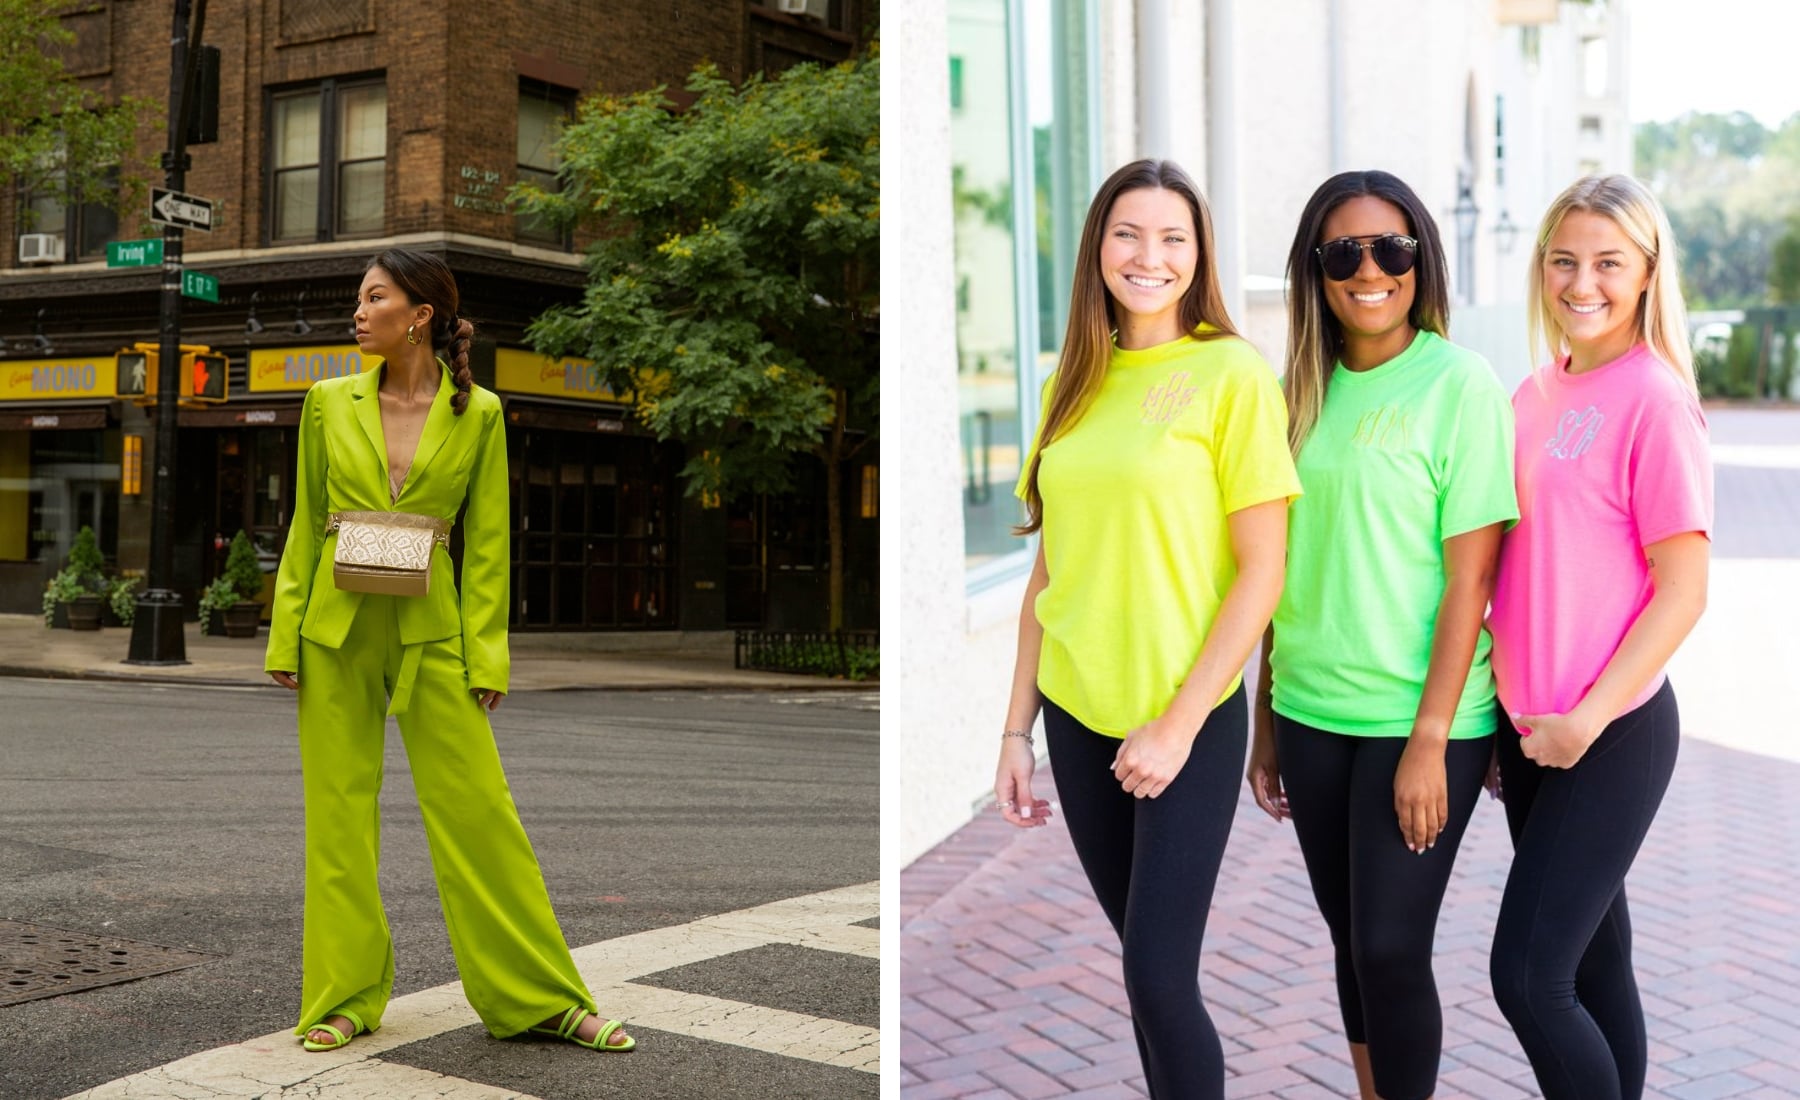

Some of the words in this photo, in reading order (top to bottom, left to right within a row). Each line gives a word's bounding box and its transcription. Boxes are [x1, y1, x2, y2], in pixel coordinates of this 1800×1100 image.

[164, 200, 182, 216] ONE
[189, 207, 207, 219] WAY
[118, 244, 145, 266] Irving
[187, 274, 194, 294] E
[32, 363, 97, 393] MONO
[284, 351, 362, 383] MONO
